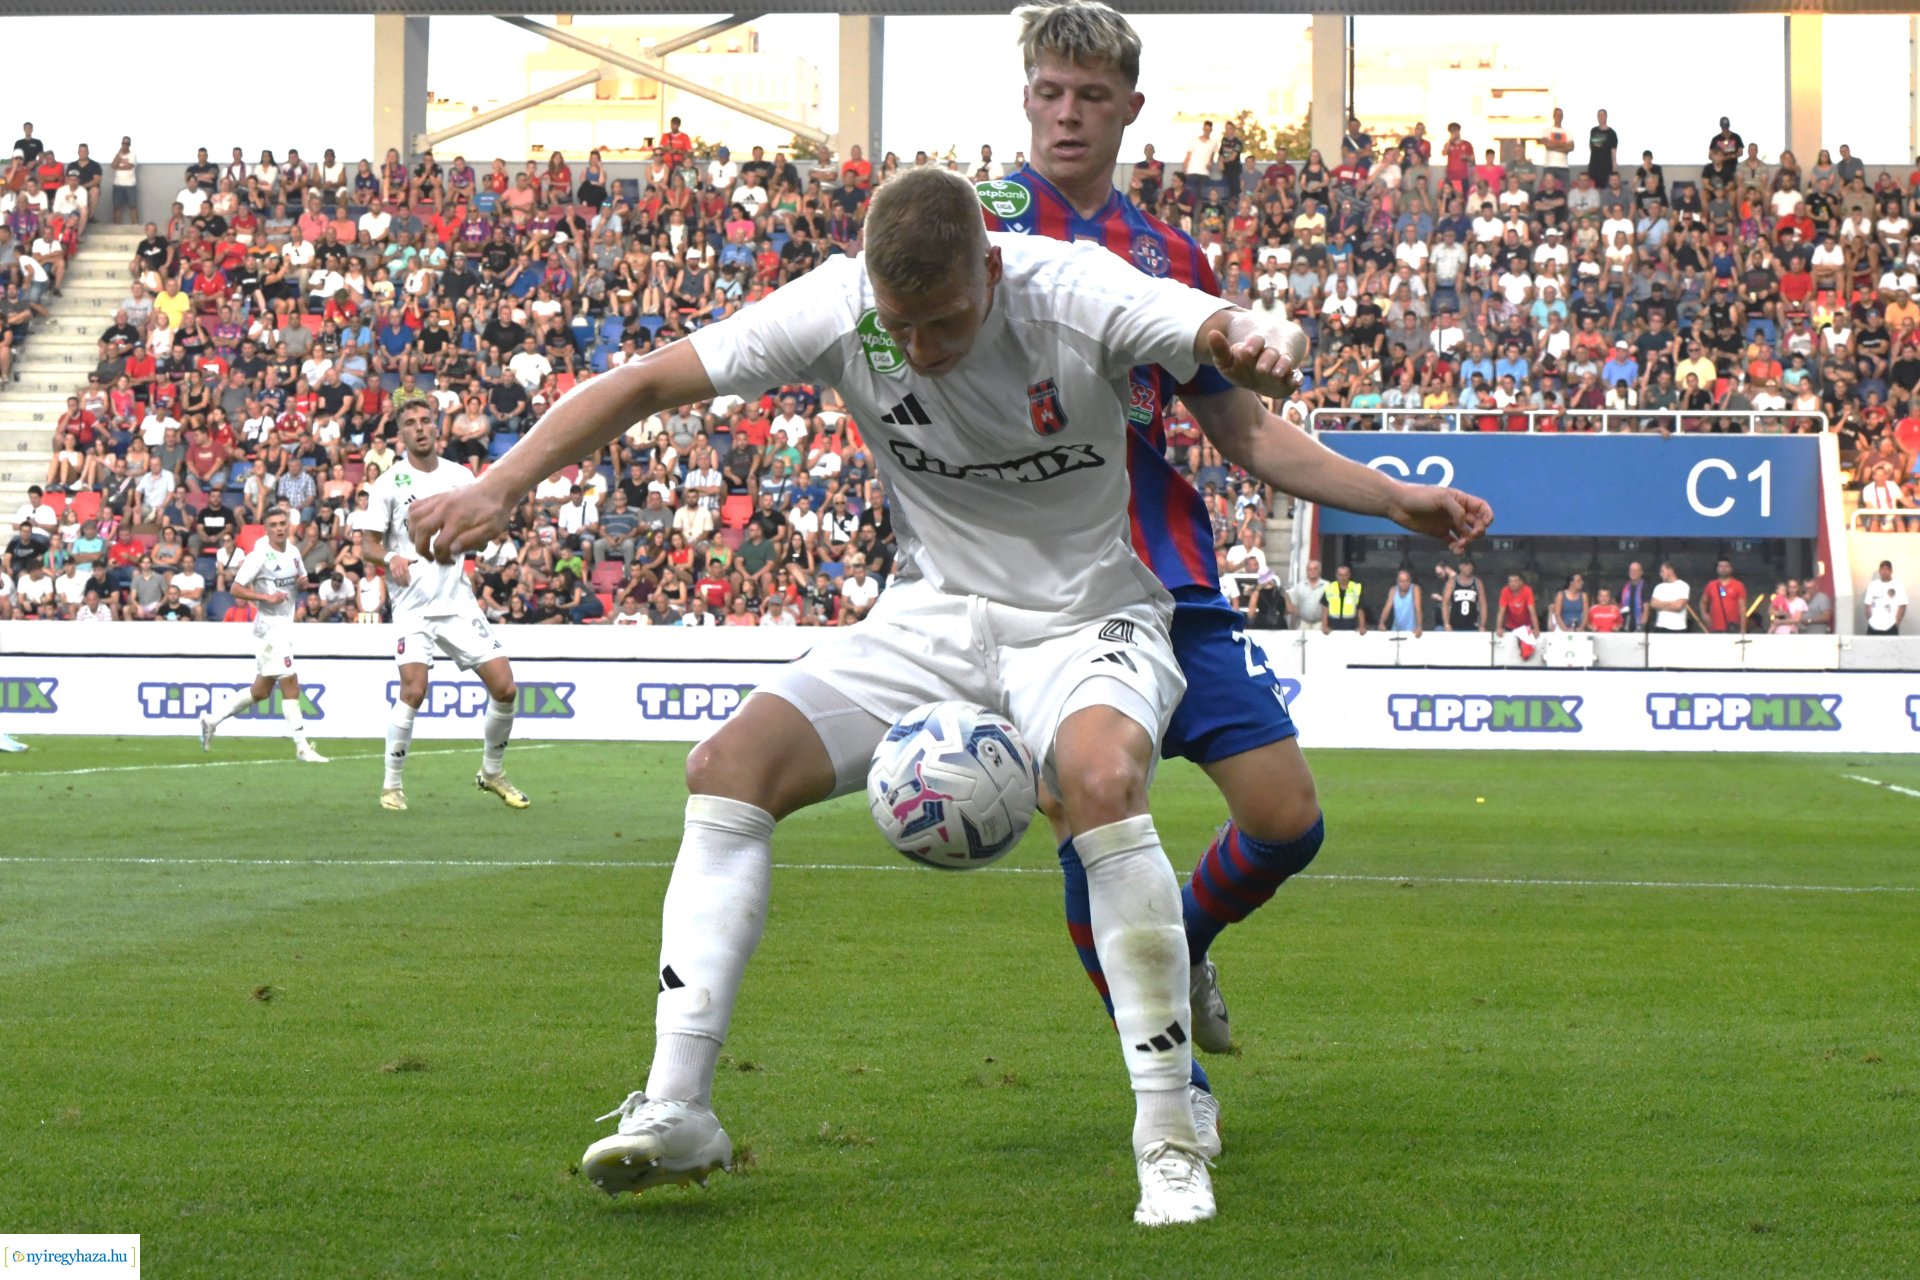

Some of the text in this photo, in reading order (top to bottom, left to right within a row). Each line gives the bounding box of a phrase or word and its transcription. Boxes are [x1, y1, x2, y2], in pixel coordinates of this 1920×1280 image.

[978, 190, 1025, 199] otpbank
[106, 271, 116, 279] 14
[77, 326, 86, 335] 12
[1686, 458, 1771, 517] C1
[1098, 619, 1135, 644] 4
